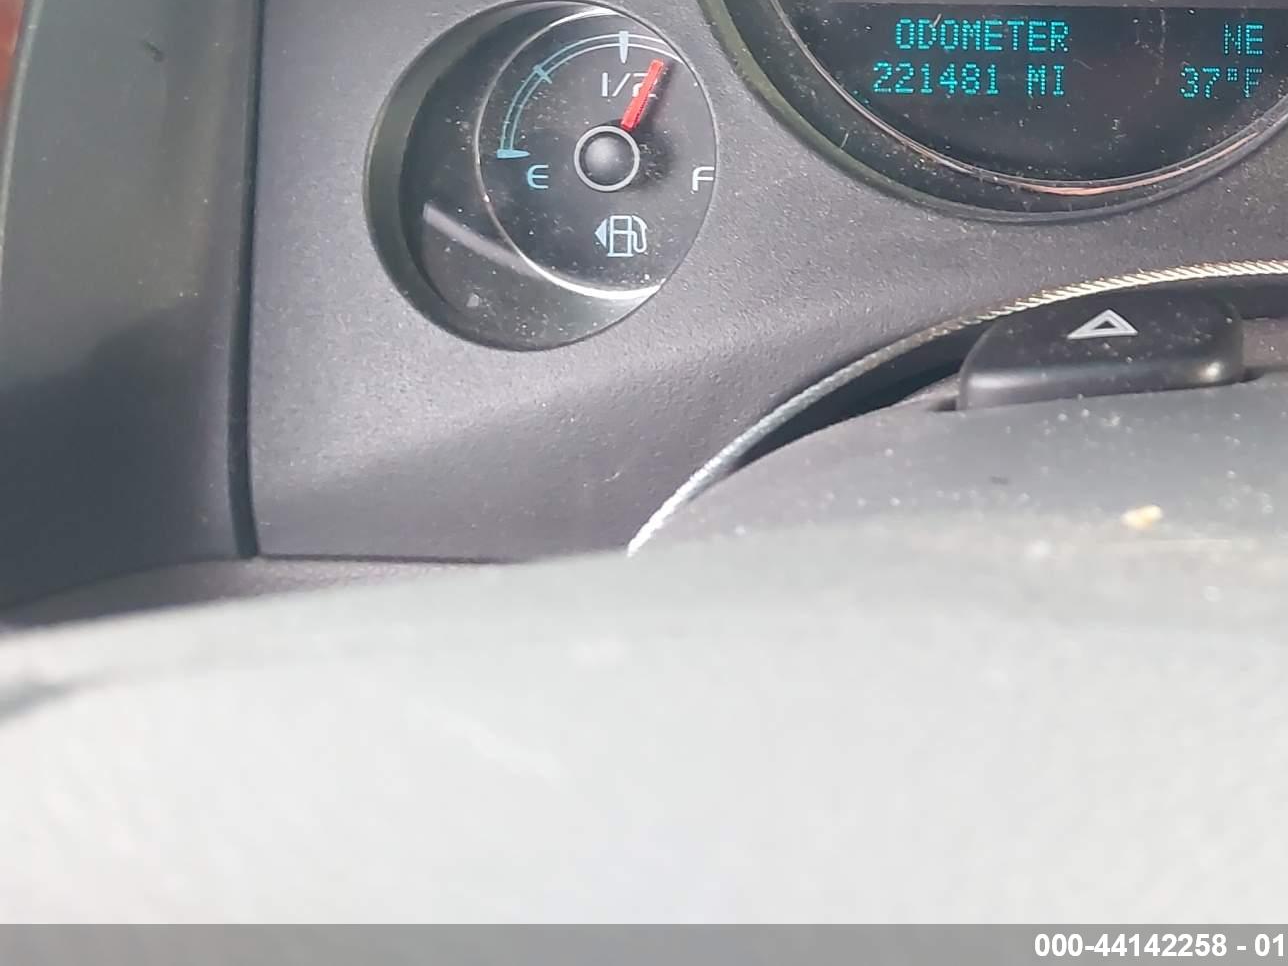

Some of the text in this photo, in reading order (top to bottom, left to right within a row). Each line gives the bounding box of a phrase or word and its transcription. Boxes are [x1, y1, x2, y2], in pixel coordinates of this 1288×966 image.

[895, 18, 1069, 52] ODOMETER
[1223, 23, 1264, 55] NE
[872, 63, 1064, 97] 221481 MI
[527, 165, 549, 189] E
[692, 166, 715, 191] F
